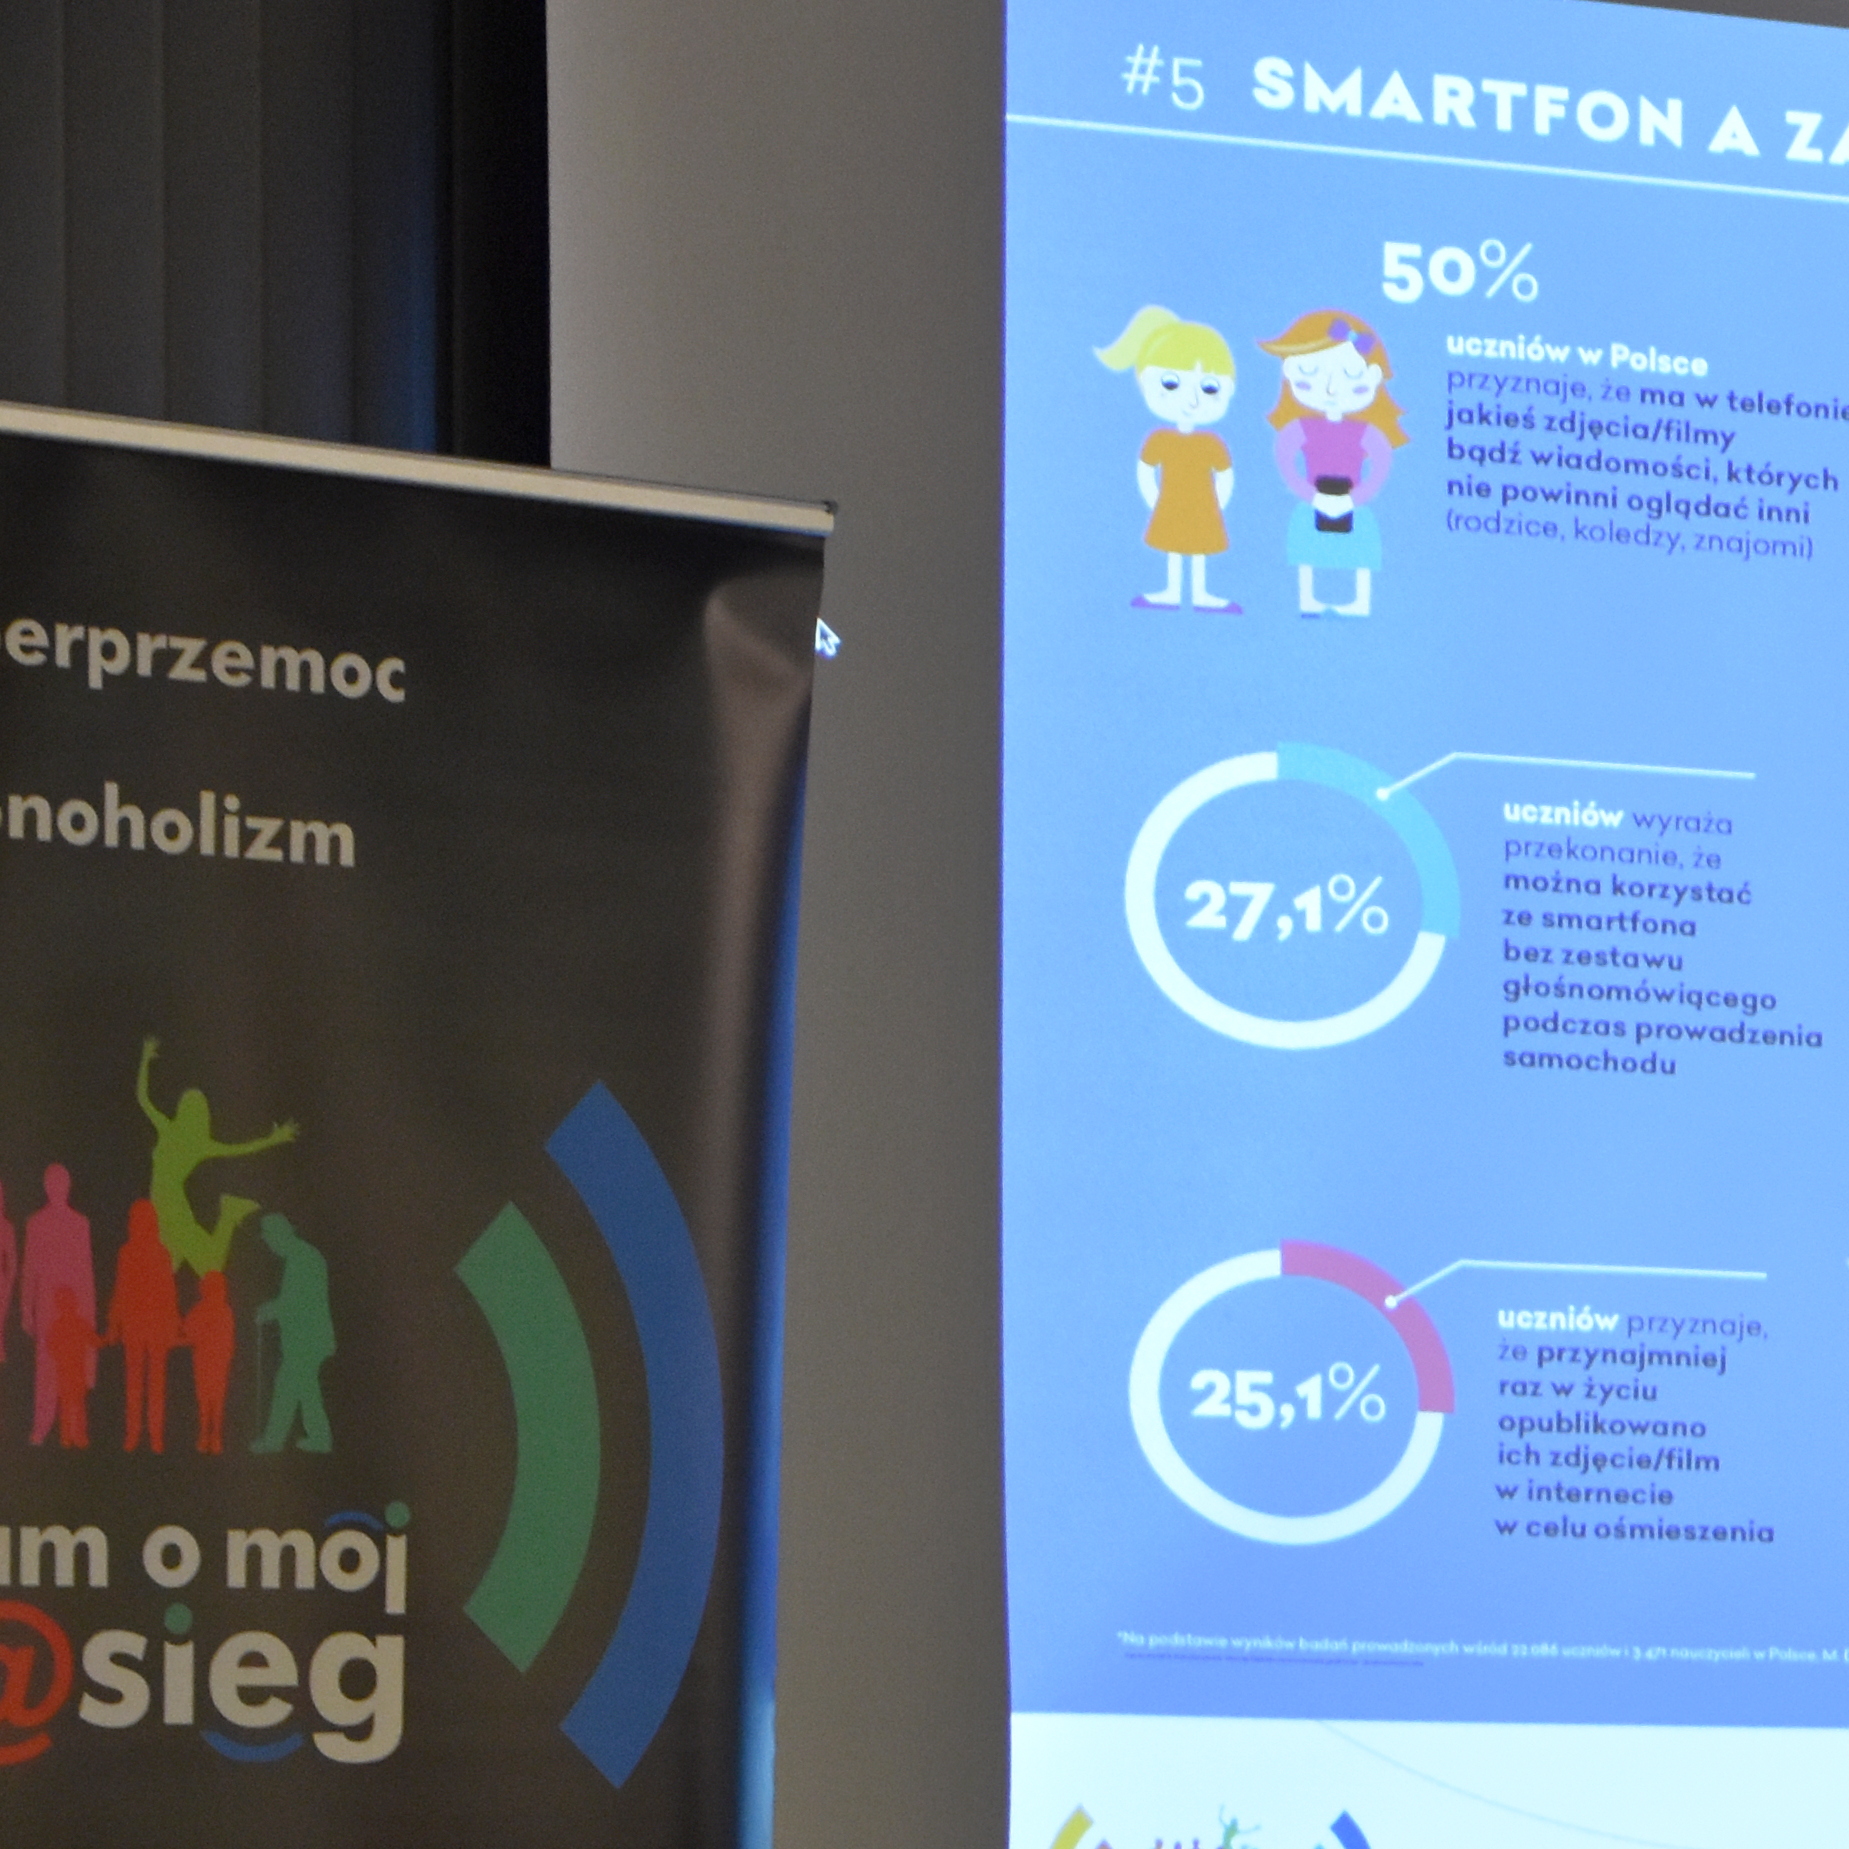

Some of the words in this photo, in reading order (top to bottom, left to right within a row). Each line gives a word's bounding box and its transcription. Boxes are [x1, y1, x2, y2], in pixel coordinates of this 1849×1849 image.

[1121, 44, 1206, 112] #5
[1252, 55, 1685, 148] SMARTFON
[1707, 104, 1762, 158] A
[1380, 238, 1540, 305] 50%
[1445, 333, 1572, 364] uczniów
[1576, 346, 1604, 366] w
[1609, 341, 1709, 378] Polsce
[1447, 371, 1593, 405] przyznaje,
[1601, 380, 1631, 402] że
[1639, 387, 1685, 408] ma
[1694, 392, 1719, 410] w
[1444, 399, 1536, 432] jakieś
[1544, 409, 1736, 454] zdjęcia/filmy
[1446, 436, 1521, 467] bądź
[1530, 445, 1718, 484] wiadomości,
[1726, 460, 1839, 495] których
[1446, 473, 1492, 500] nie
[1501, 482, 1618, 510] powinni
[1626, 490, 1748, 521] oglądać
[1757, 498, 1810, 525] inni
[1445, 508, 1566, 542] (rodzice,
[1573, 515, 1686, 556] koledzy,
[1694, 533, 1814, 562] znajomi)
[0, 780, 357, 869] noholizm
[1502, 799, 1625, 828] uczniów
[1632, 810, 1733, 838] wyraża
[1504, 835, 1684, 870] przekonanie,
[1692, 846, 1722, 871] że
[1183, 872, 1391, 943] 27,1%
[1503, 869, 1602, 896] można
[1611, 873, 1752, 908] korzystać
[1502, 908, 1534, 928] ze
[1541, 909, 1697, 938] smartfona
[1503, 937, 1553, 965] bez
[1562, 945, 1684, 972] zestawu
[1502, 973, 1777, 1017] głośnomówiącego
[1502, 1010, 1627, 1039] podczas
[1635, 1021, 1823, 1049] prowadzenia
[1502, 1048, 1676, 1077] samochodu
[1497, 1304, 1620, 1333] uczniów
[1627, 1314, 1768, 1344] przyznaje,
[1499, 1338, 1528, 1361] że
[1536, 1343, 1727, 1377] przynajmniej
[1188, 1360, 1388, 1431] 25,1%
[1498, 1379, 1543, 1398] raz
[1550, 1382, 1575, 1398] w
[1584, 1376, 1658, 1408] życiu
[1497, 1410, 1707, 1440] opublikowano
[1498, 1442, 1541, 1467] ich
[1550, 1445, 1720, 1476] zdjęcie/film
[1495, 1484, 1519, 1501] w
[1527, 1478, 1674, 1506] internecie
[1494, 1520, 1518, 1536] w
[1525, 1514, 1587, 1540] celu
[1593, 1516, 1775, 1544] ośmieszenia
[142, 1523, 202, 1590] o
